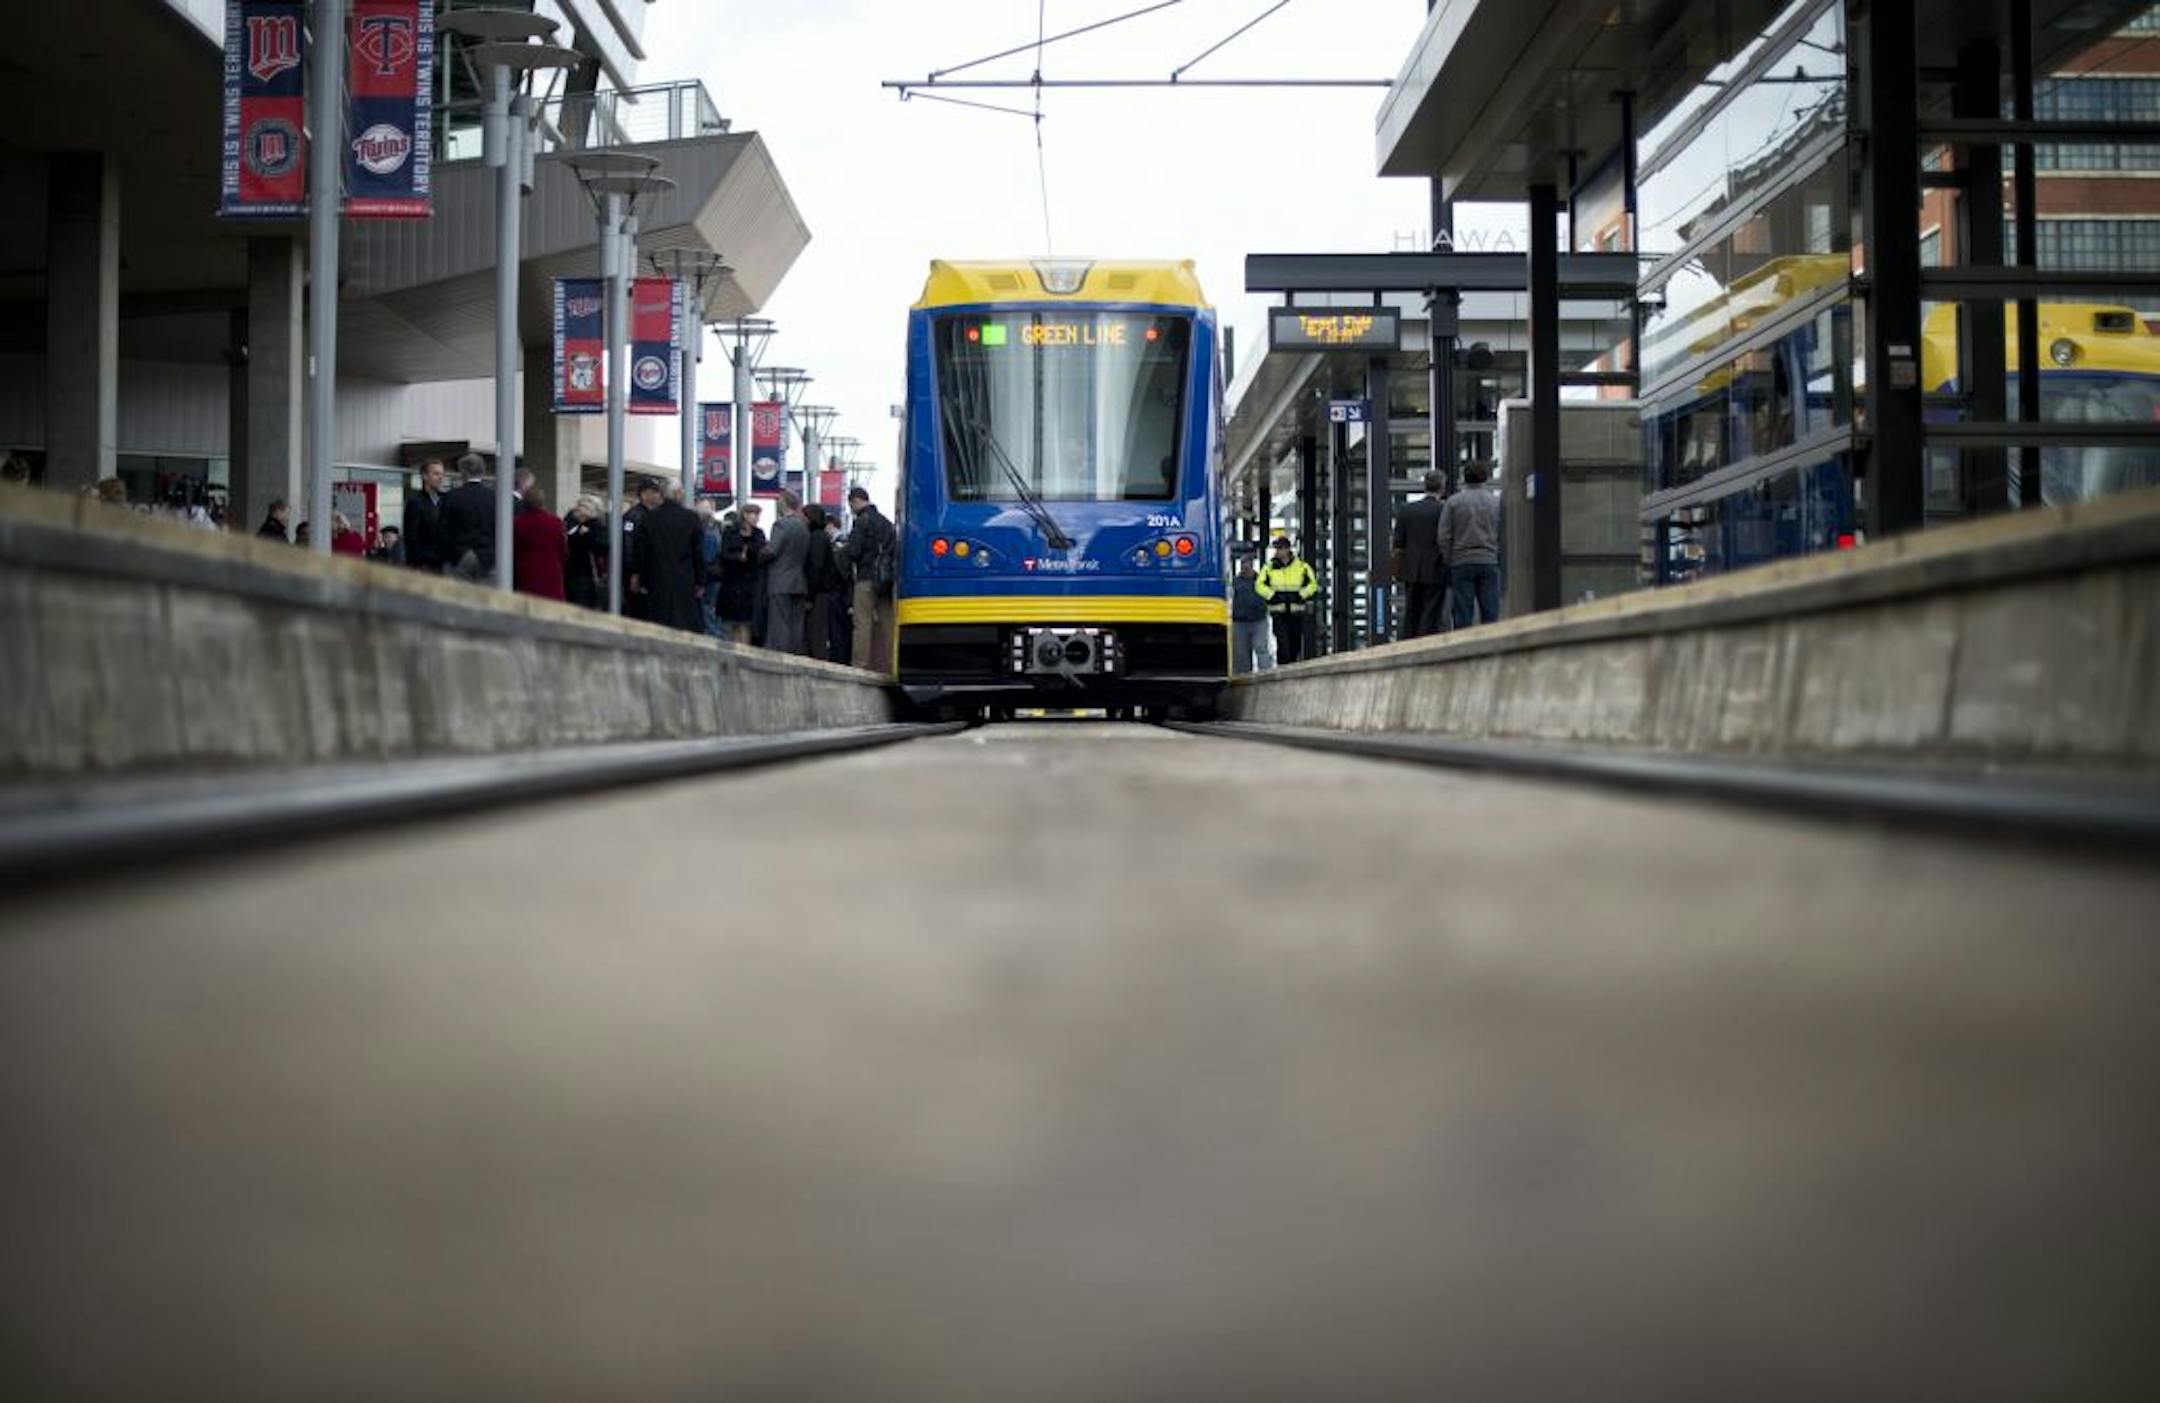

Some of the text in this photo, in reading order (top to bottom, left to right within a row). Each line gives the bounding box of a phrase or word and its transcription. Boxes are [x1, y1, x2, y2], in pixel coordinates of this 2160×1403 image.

[417, 39, 434, 53] IS
[415, 60, 433, 107] TWINS
[224, 88, 240, 137] TWINS
[224, 141, 239, 156] IS
[412, 112, 432, 193] TERRITORY
[223, 161, 239, 195] THIS
[1022, 323, 1126, 345] GREEN LINE
[1146, 515, 1181, 528] 201A
